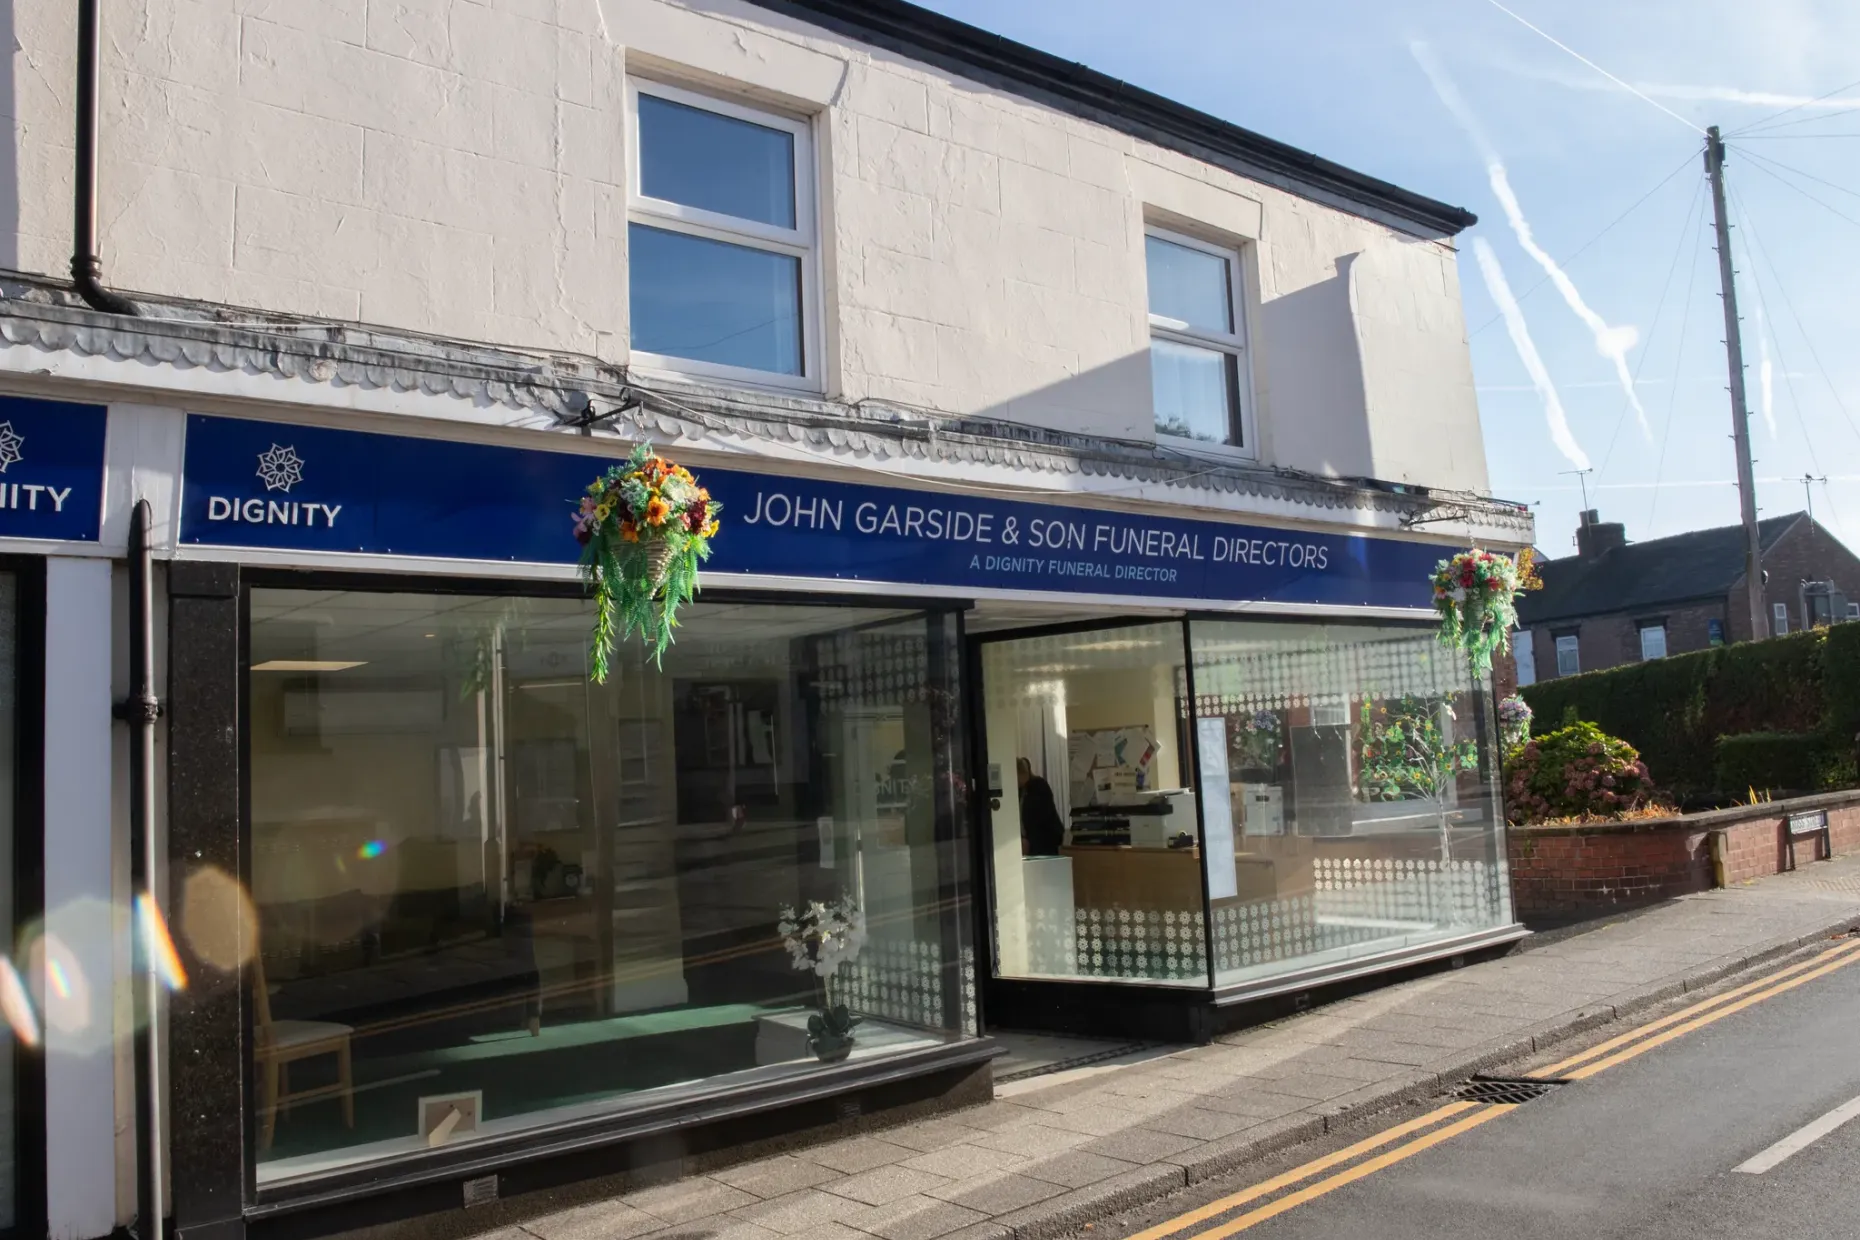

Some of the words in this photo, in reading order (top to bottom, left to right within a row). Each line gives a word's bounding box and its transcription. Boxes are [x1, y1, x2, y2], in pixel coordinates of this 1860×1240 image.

[0, 483, 72, 512] ITY
[208, 496, 342, 528] DIGNITY
[743, 491, 843, 531] JOHN
[855, 502, 995, 543] GARSIDE
[1001, 516, 1019, 546] &
[1028, 520, 1086, 550] SON
[1094, 525, 1205, 561] FUNERAL
[1213, 536, 1329, 570] DIRECTORS
[969, 554, 980, 570] A
[985, 555, 1045, 574] DIGNITY
[1048, 560, 1111, 578] FUNERAL
[1115, 565, 1178, 582] DIRECTOR
